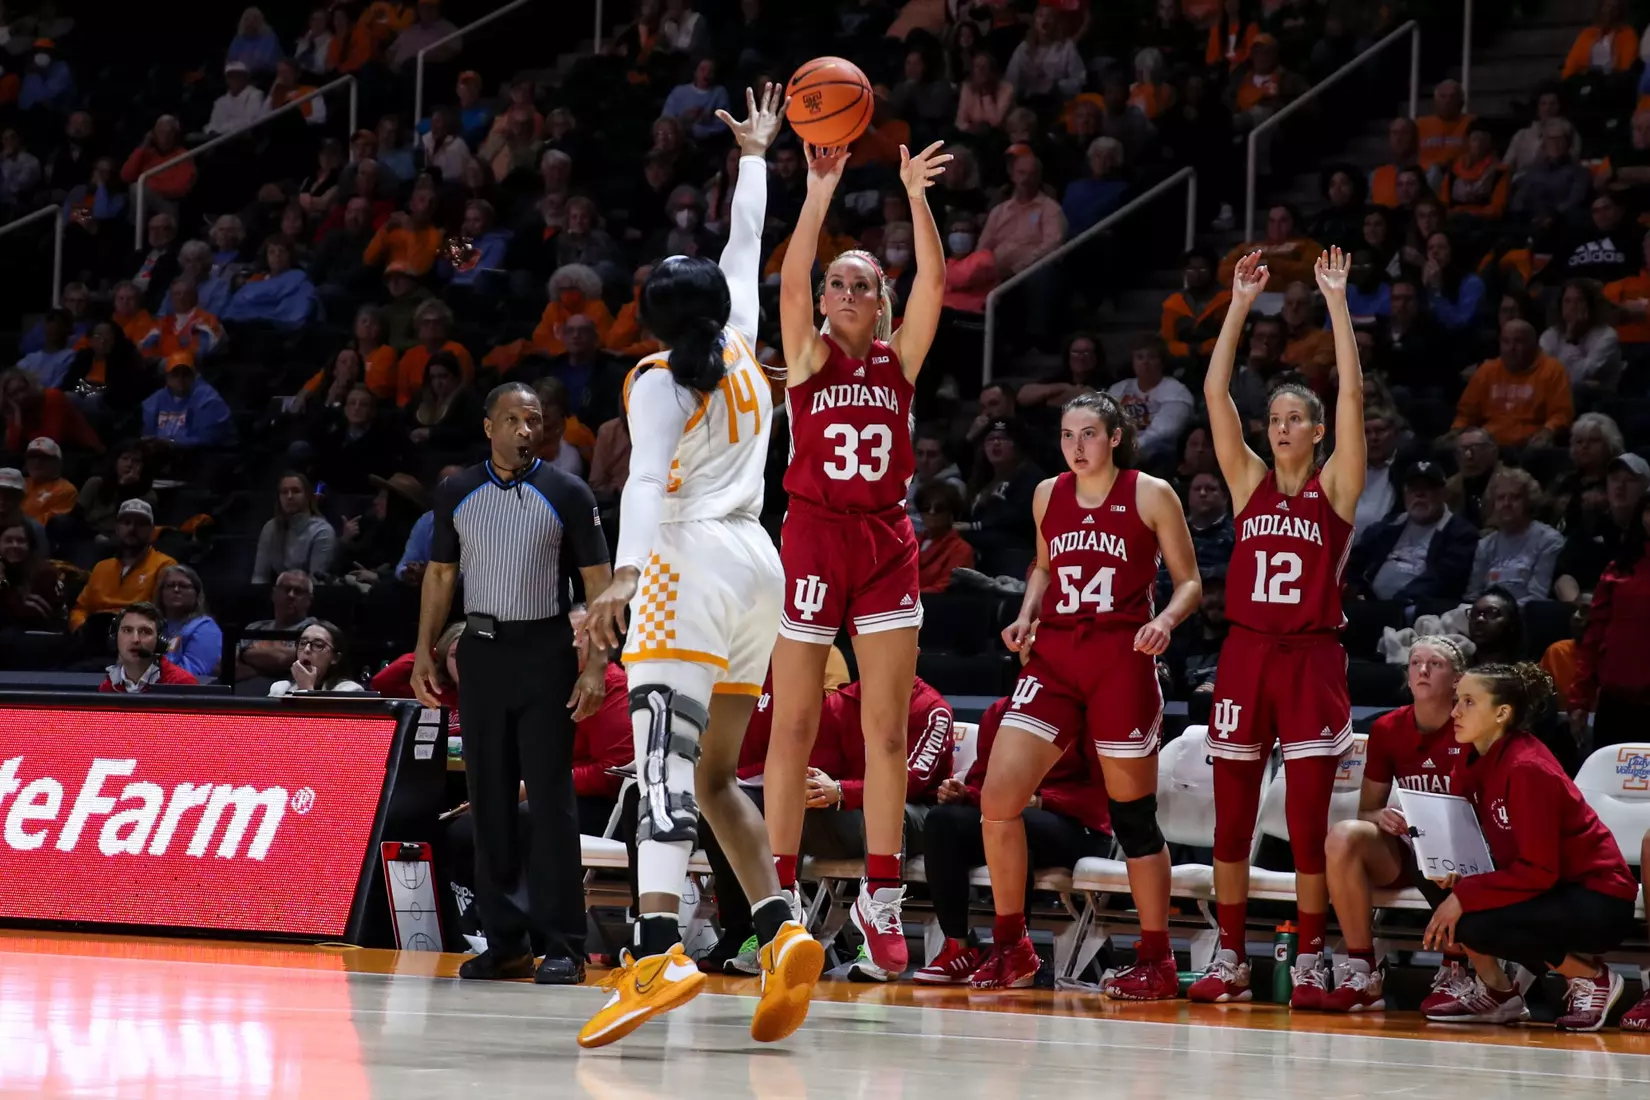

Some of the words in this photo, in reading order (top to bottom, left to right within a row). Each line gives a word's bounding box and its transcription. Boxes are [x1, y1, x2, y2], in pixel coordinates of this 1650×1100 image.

[718, 369, 760, 443] 14
[811, 384, 899, 415] INDIANA
[823, 423, 892, 481] 33
[1050, 530, 1127, 562] INDIANA
[1241, 514, 1323, 546] INDIANA
[1055, 565, 1116, 614] 54
[1251, 550, 1302, 604] 12
[912, 715, 949, 771] INDIANA
[1398, 774, 1451, 794] NDIA
